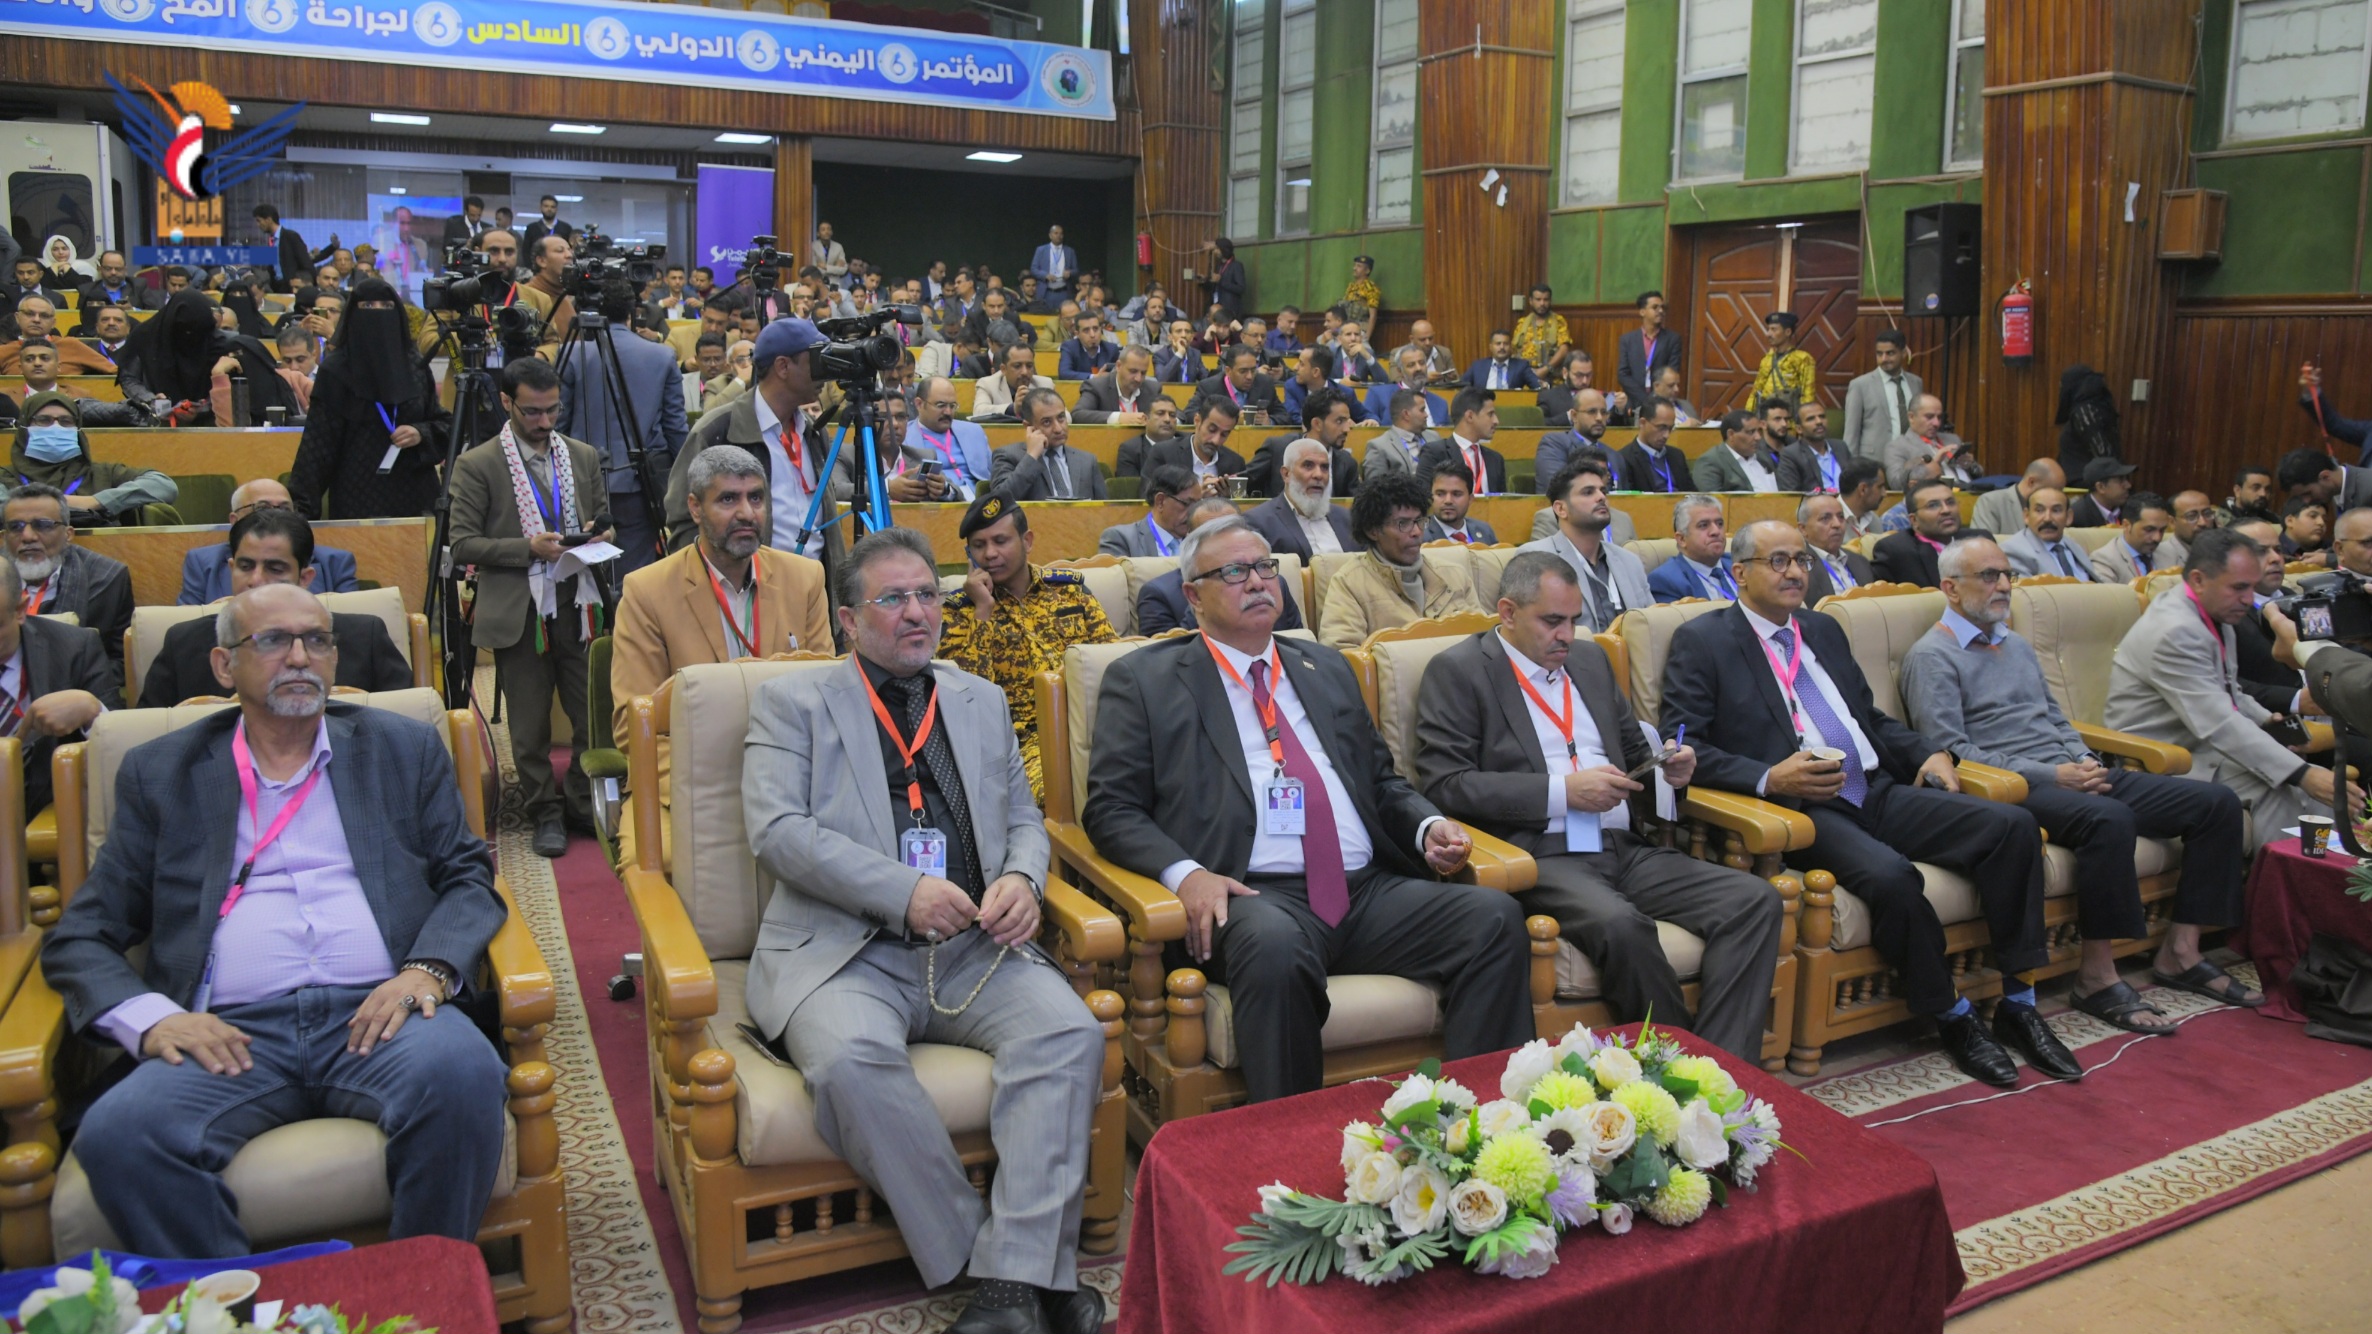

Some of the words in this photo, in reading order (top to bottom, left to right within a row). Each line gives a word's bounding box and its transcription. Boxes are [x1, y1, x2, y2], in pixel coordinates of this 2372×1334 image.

[306, 0, 408, 37] لجراحة
[466, 19, 581, 46] السادس
[634, 31, 735, 62] الدولي
[784, 44, 876, 75] اليمني
[922, 54, 1015, 86] المؤتمر
